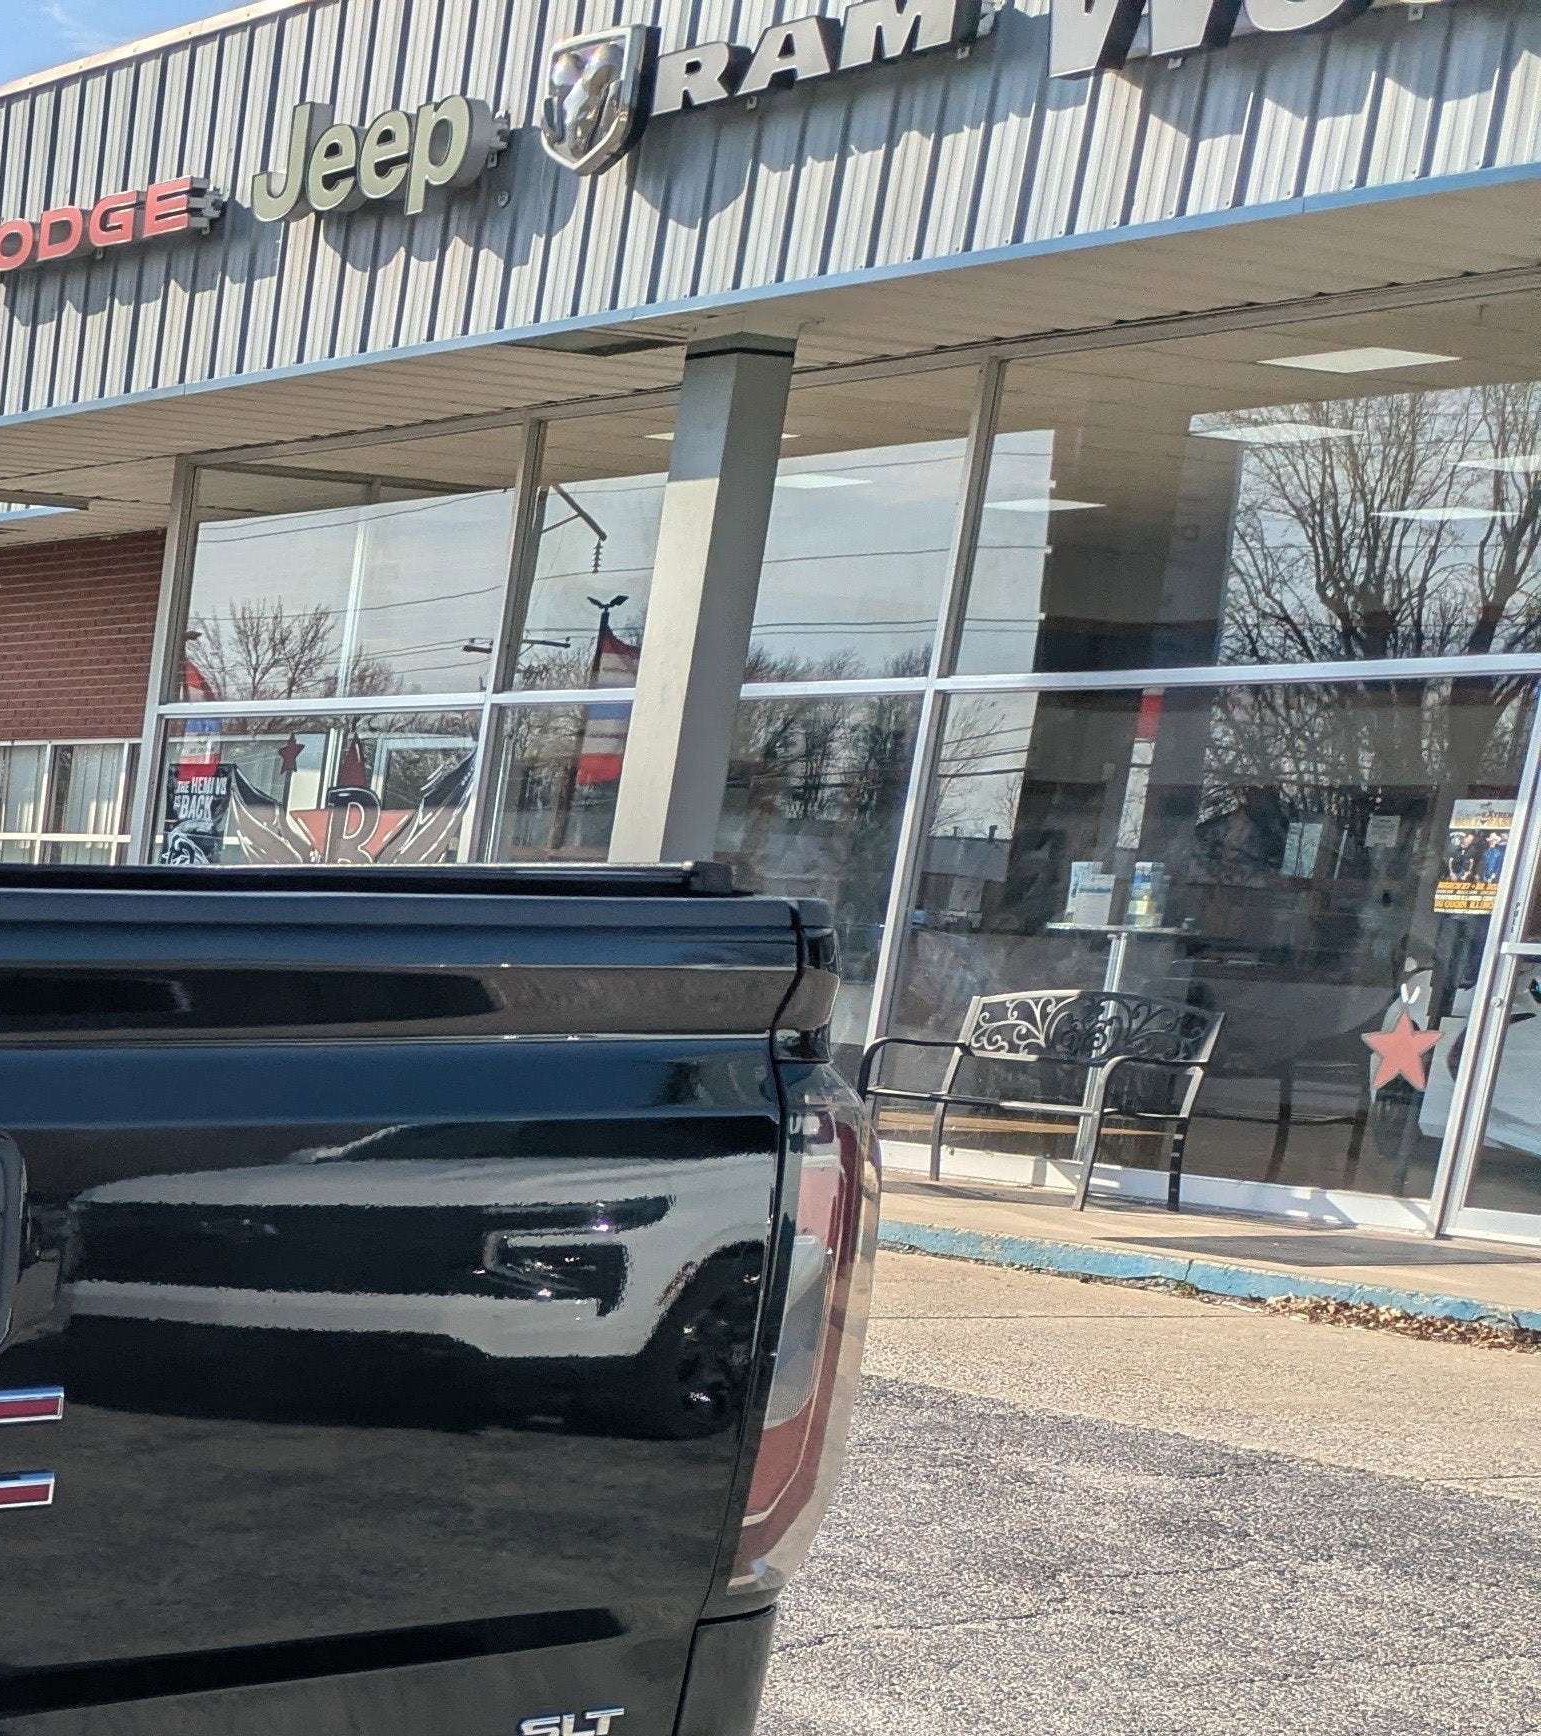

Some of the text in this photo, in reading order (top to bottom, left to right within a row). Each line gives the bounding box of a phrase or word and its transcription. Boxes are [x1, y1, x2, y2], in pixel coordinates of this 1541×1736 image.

[651, 0, 958, 117] RAM
[250, 93, 474, 223] Jeep
[179, 794, 215, 821] BACK
[191, 776, 215, 795] HEMI
